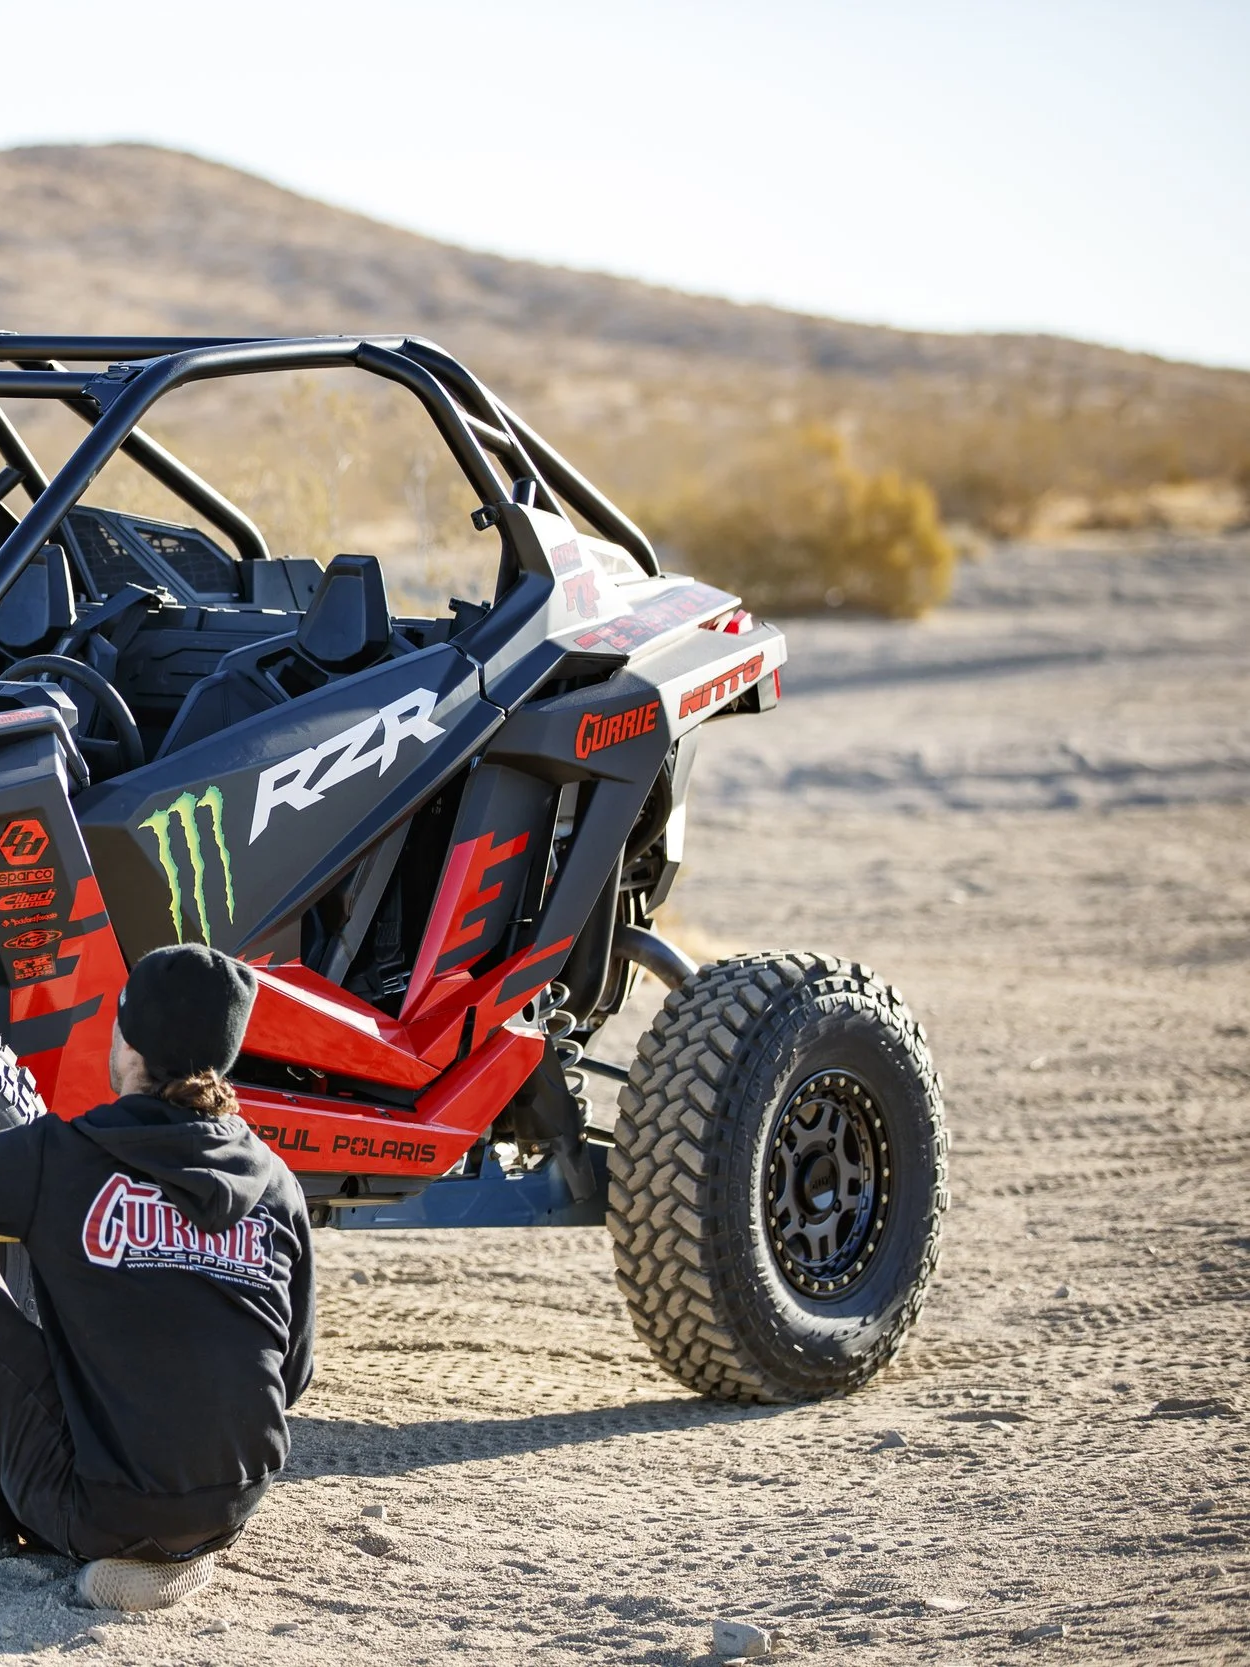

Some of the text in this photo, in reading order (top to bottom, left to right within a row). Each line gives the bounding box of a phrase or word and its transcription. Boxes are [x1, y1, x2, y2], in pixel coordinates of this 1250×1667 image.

[678, 651, 765, 719] NITTO
[574, 700, 660, 760] CURRIE
[248, 687, 447, 846] RZR
[247, 1123, 437, 1163] PUL POLARIS
